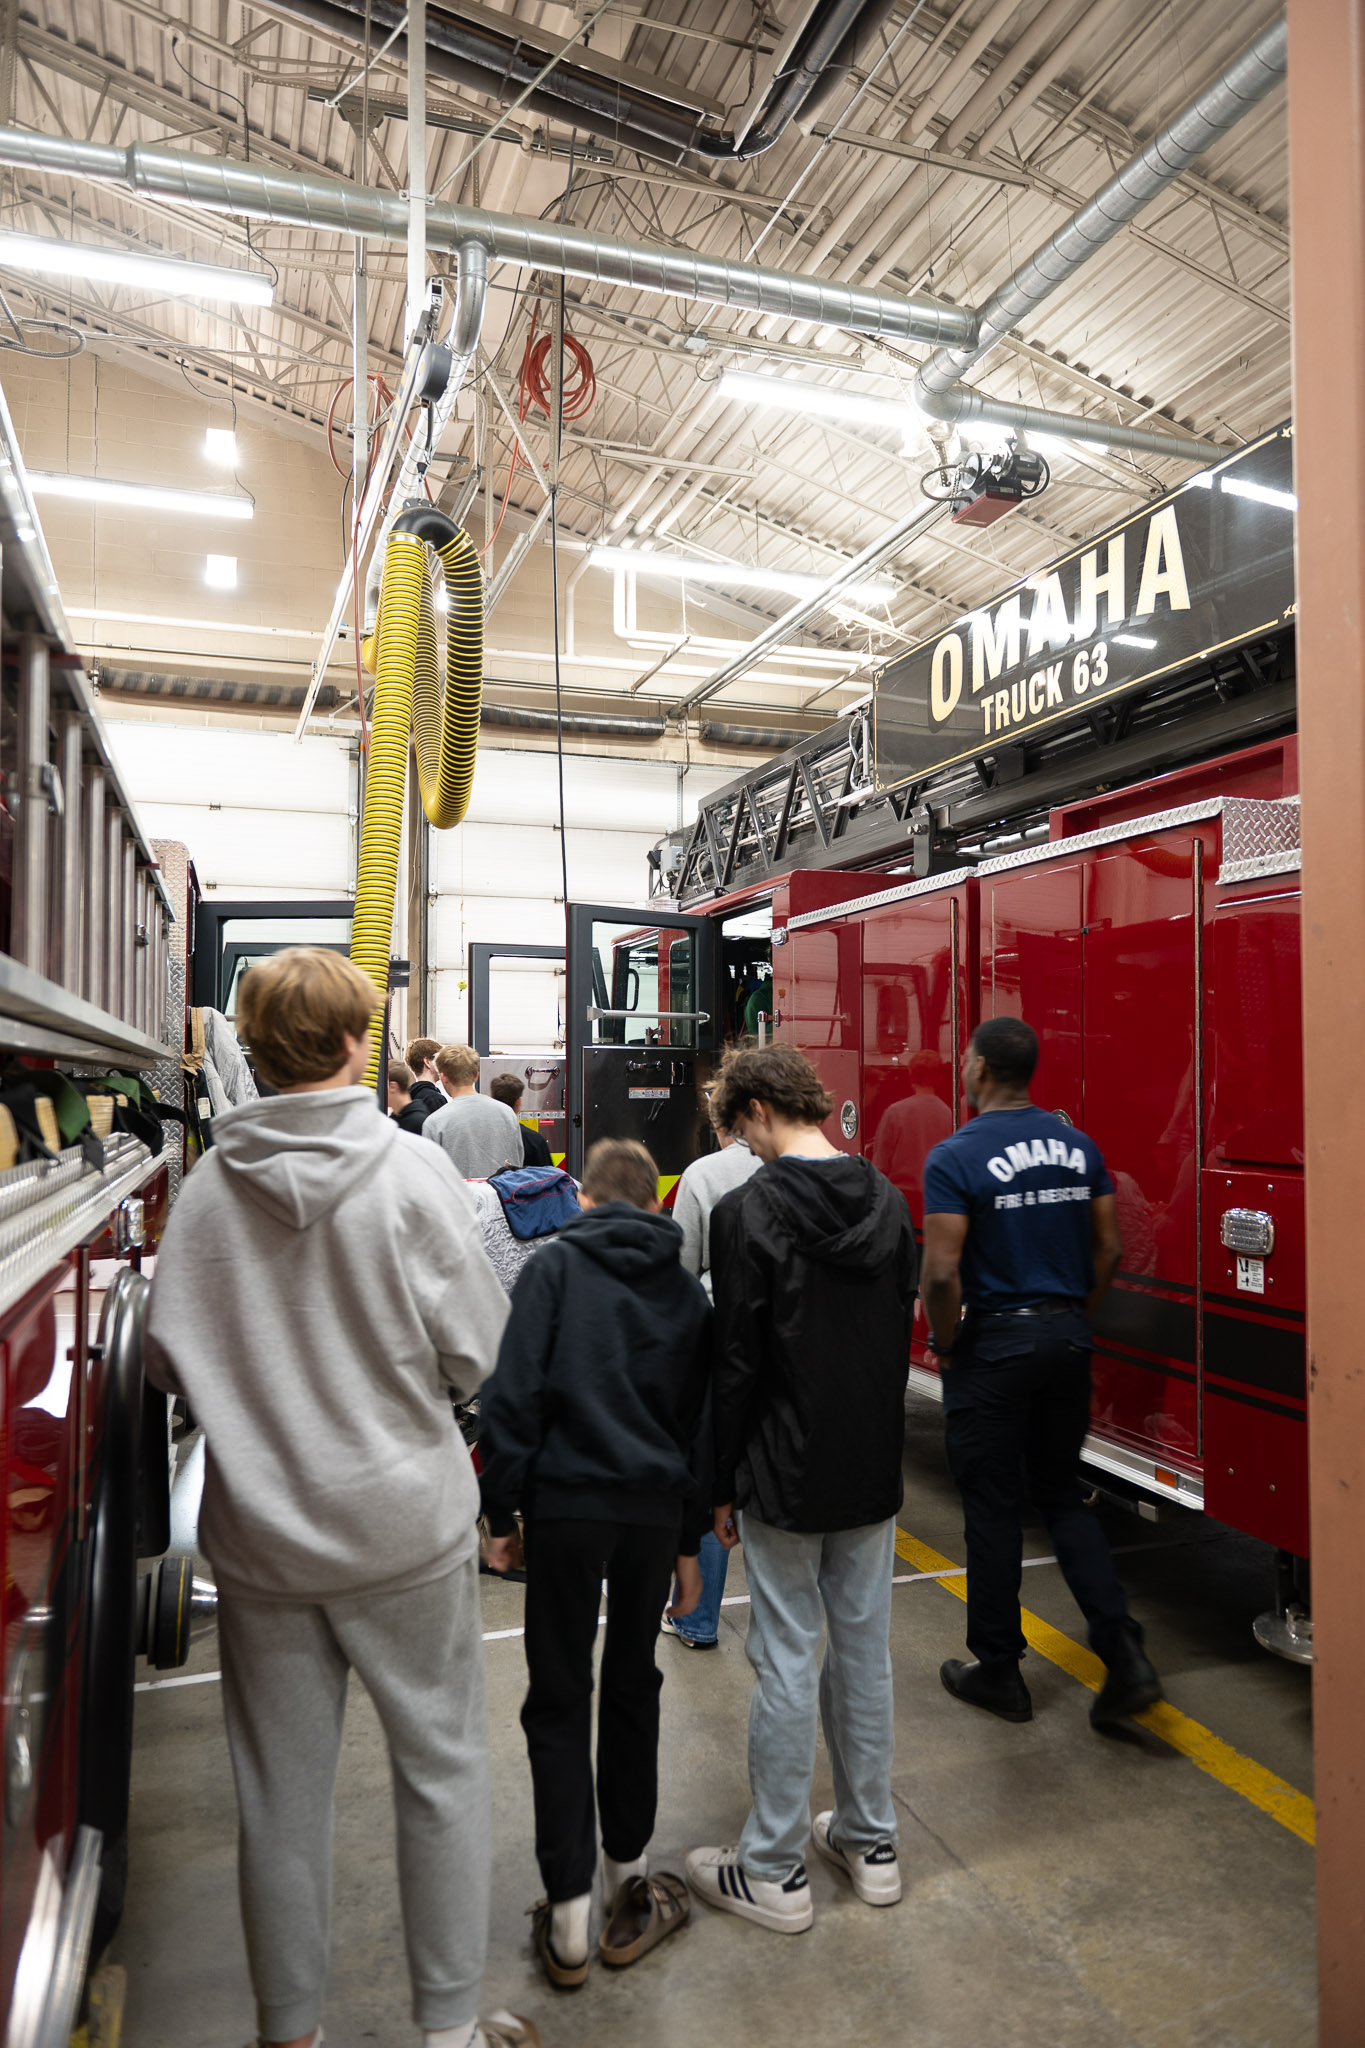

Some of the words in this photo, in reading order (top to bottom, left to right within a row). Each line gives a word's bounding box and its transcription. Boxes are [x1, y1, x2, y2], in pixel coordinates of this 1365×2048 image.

[931, 503, 1191, 723] OMAHA
[980, 660, 1065, 736] TRUCK
[1072, 641, 1109, 696] 63
[986, 1138, 1087, 1183] OMAHA
[994, 1193, 1023, 1209] FIRE
[1037, 1186, 1091, 1203] RESCUE
